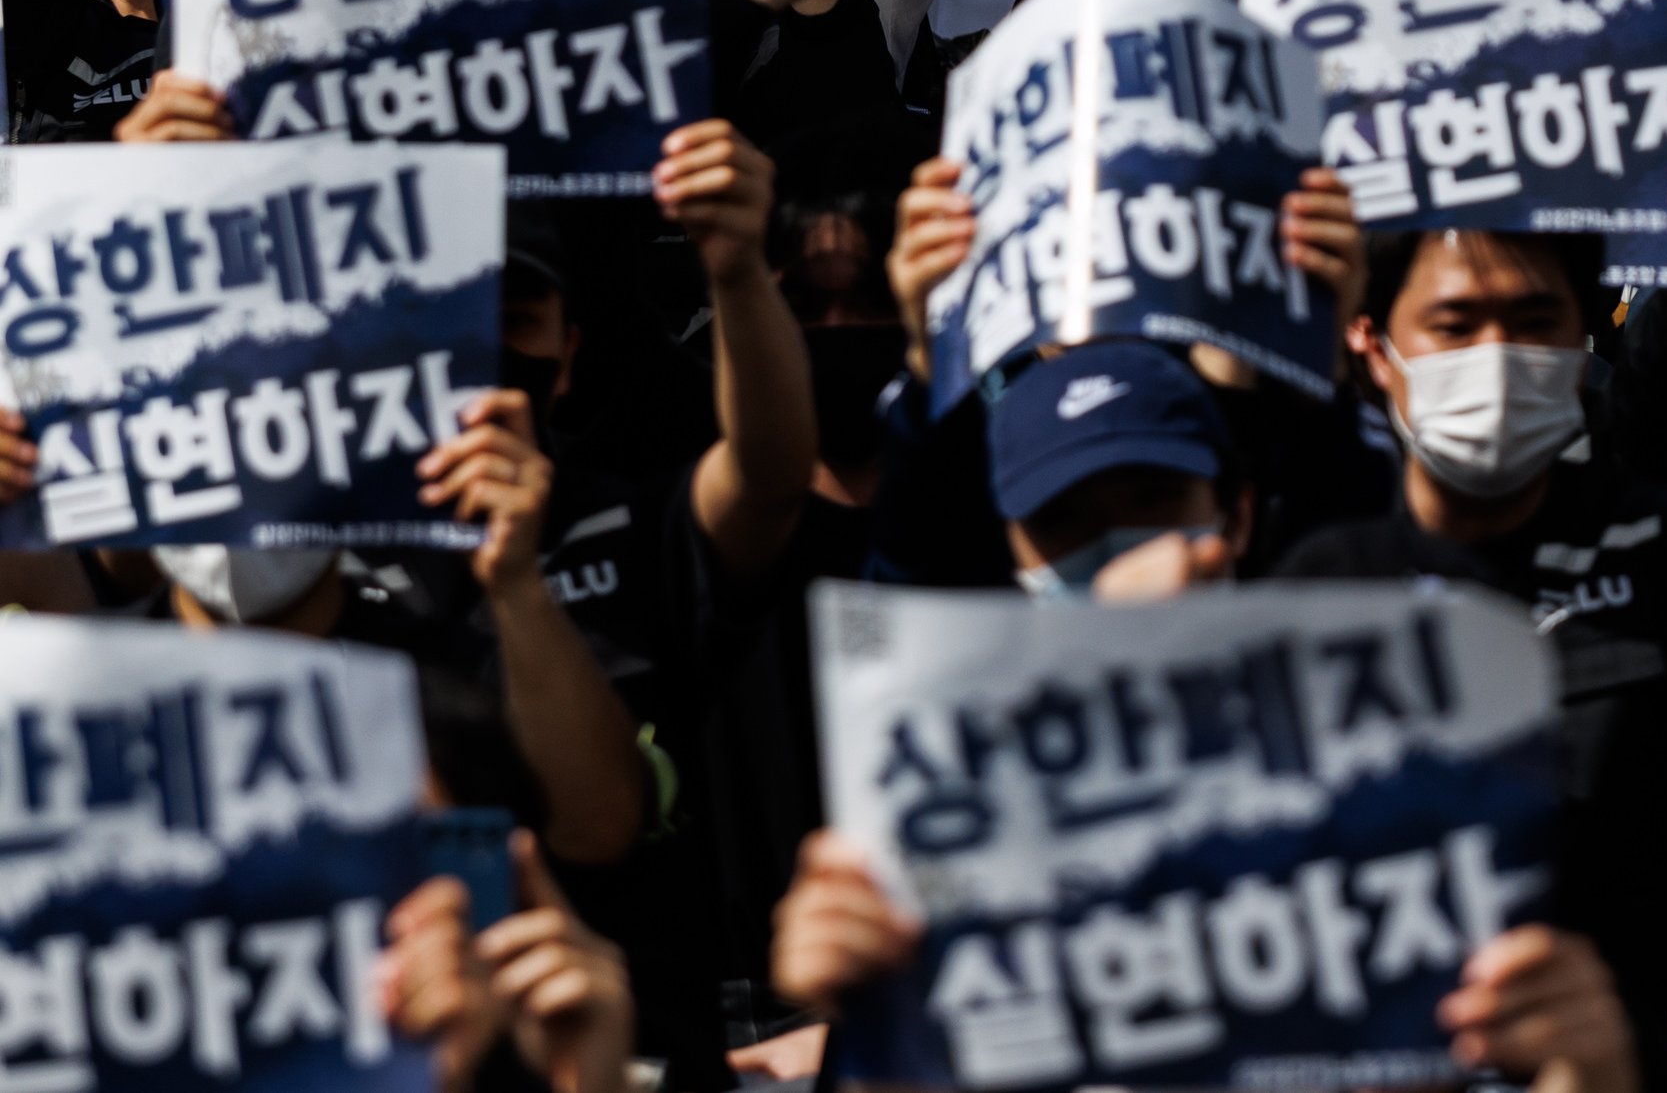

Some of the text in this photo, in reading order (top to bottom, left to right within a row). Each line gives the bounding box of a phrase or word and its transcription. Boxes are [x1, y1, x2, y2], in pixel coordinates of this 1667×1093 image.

[256, 7, 710, 147] 실현하자
[2, 163, 438, 363] 상한폐지
[35, 352, 480, 549] 실현하자
[0, 897, 392, 1089] 하자
[928, 822, 1550, 1089] 실현하자
